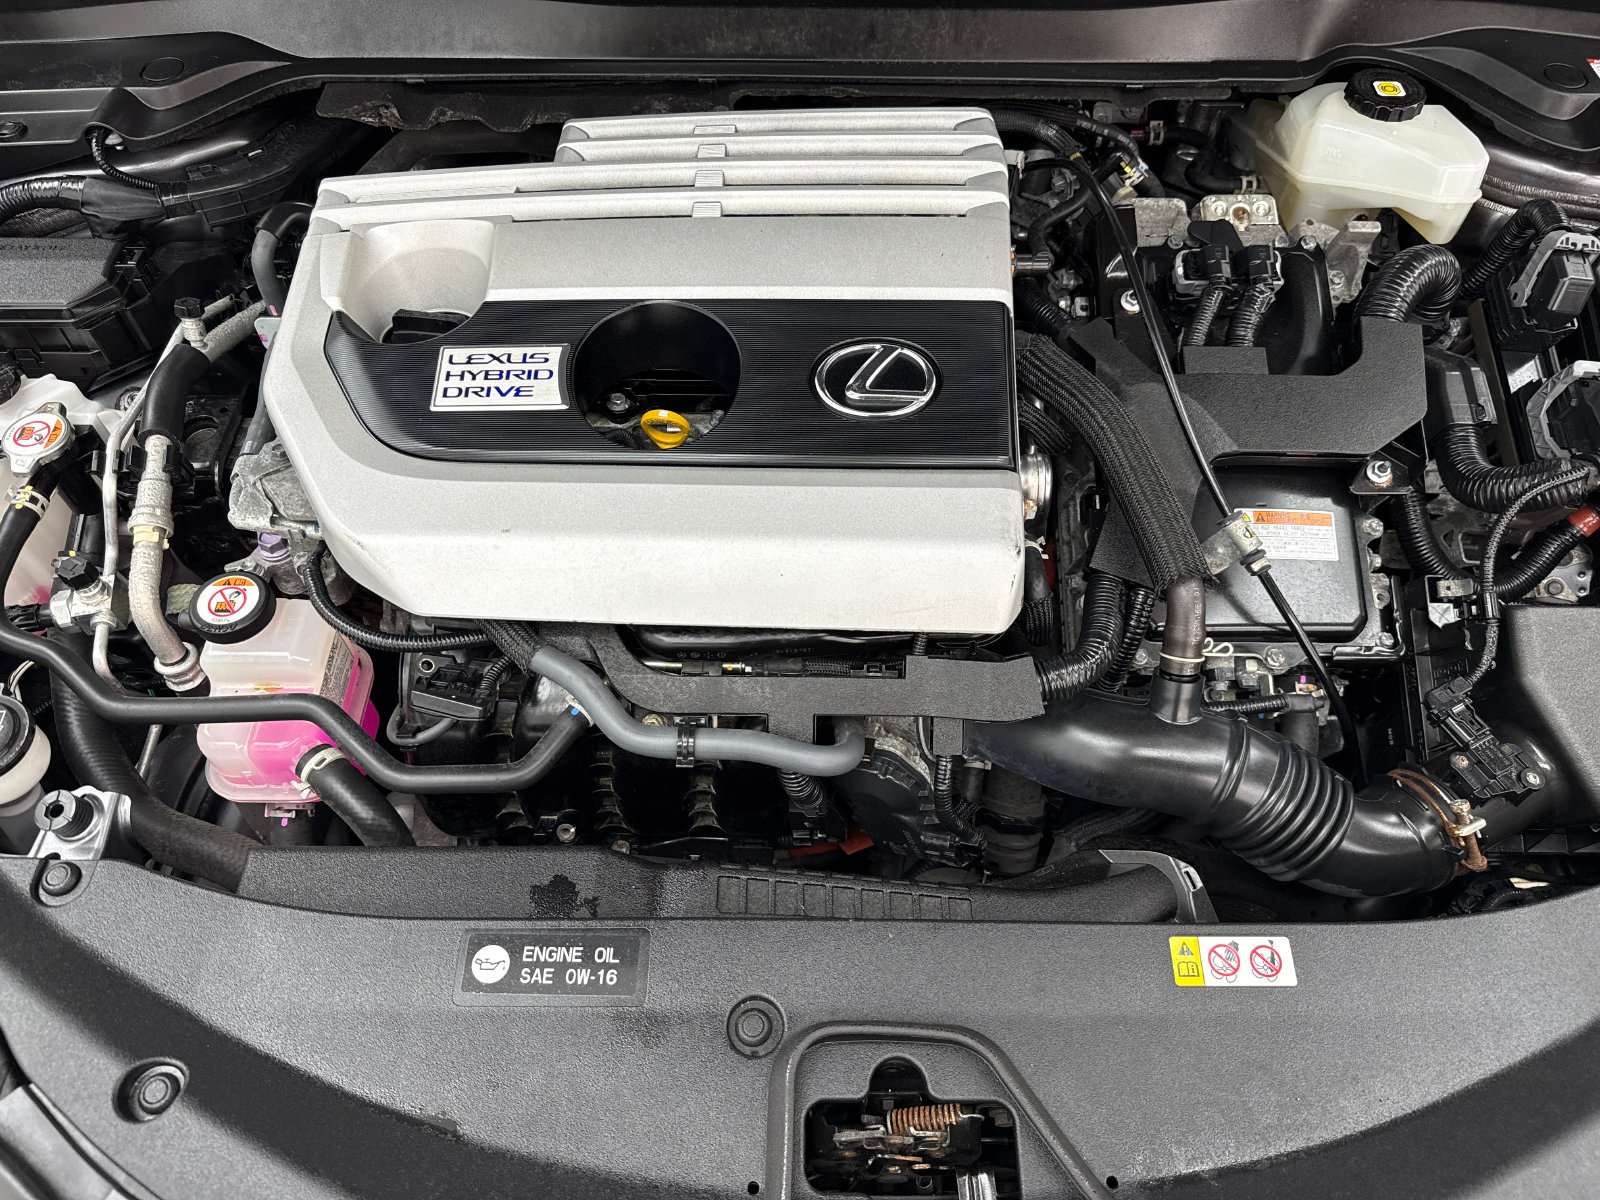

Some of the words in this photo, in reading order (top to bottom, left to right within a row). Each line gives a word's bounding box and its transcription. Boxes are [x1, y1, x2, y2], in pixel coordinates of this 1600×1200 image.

[448, 352, 550, 365] LEXUS
[444, 369, 554, 381] HYBRID
[442, 386, 535, 398] DRIVE
[522, 945, 584, 963] ENGINE
[594, 947, 620, 963] OIL
[519, 968, 555, 985] SAE
[565, 969, 618, 985] 0W-16
